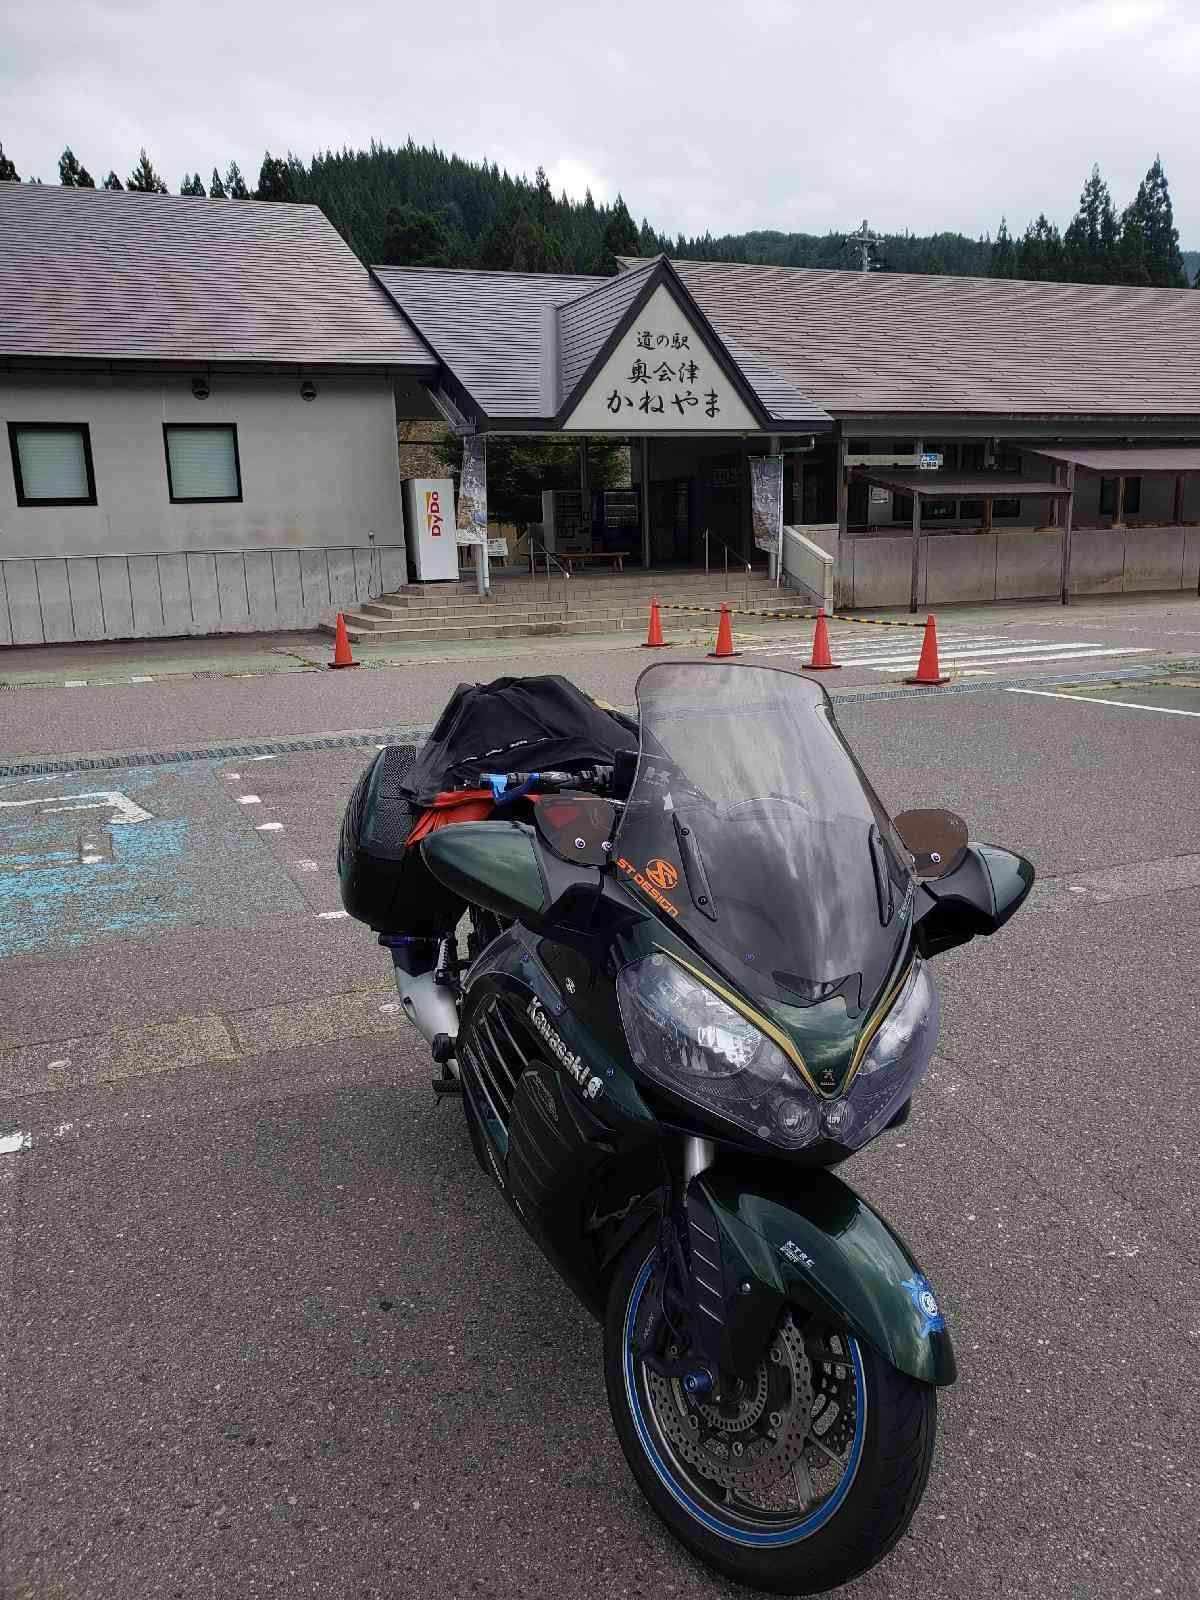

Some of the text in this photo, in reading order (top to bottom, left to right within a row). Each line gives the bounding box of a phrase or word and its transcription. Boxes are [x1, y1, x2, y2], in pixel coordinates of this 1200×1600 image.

[636, 331, 691, 351] 道の駅
[626, 359, 700, 385] 奥会津
[606, 389, 721, 418] かねやま
[430, 491, 444, 537] DyDo
[526, 995, 591, 1086] Kawasaki
